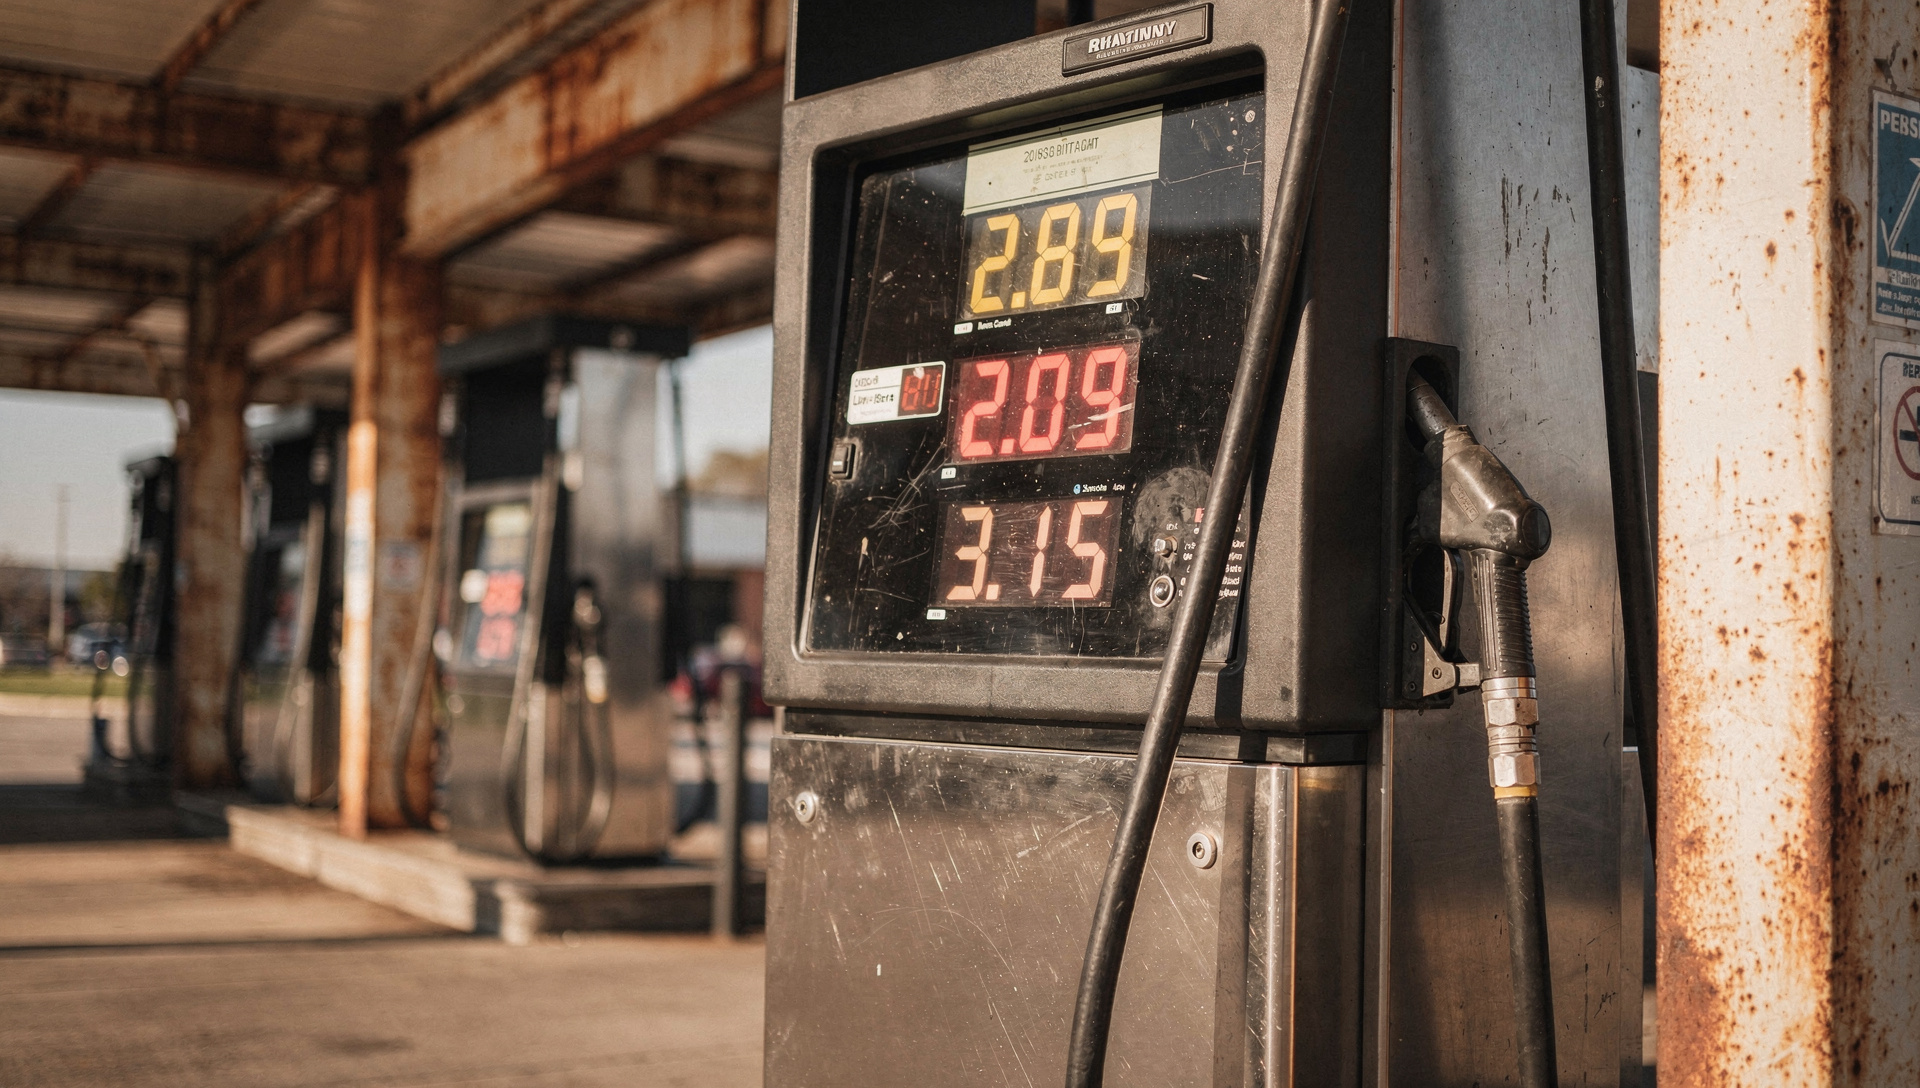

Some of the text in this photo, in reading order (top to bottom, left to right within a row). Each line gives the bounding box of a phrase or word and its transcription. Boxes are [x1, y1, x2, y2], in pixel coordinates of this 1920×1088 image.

[1880, 109, 1920, 139] PEBS
[970, 193, 1138, 314] 2.89
[960, 347, 1127, 457] 2.09
[946, 500, 1108, 600] 3.15
